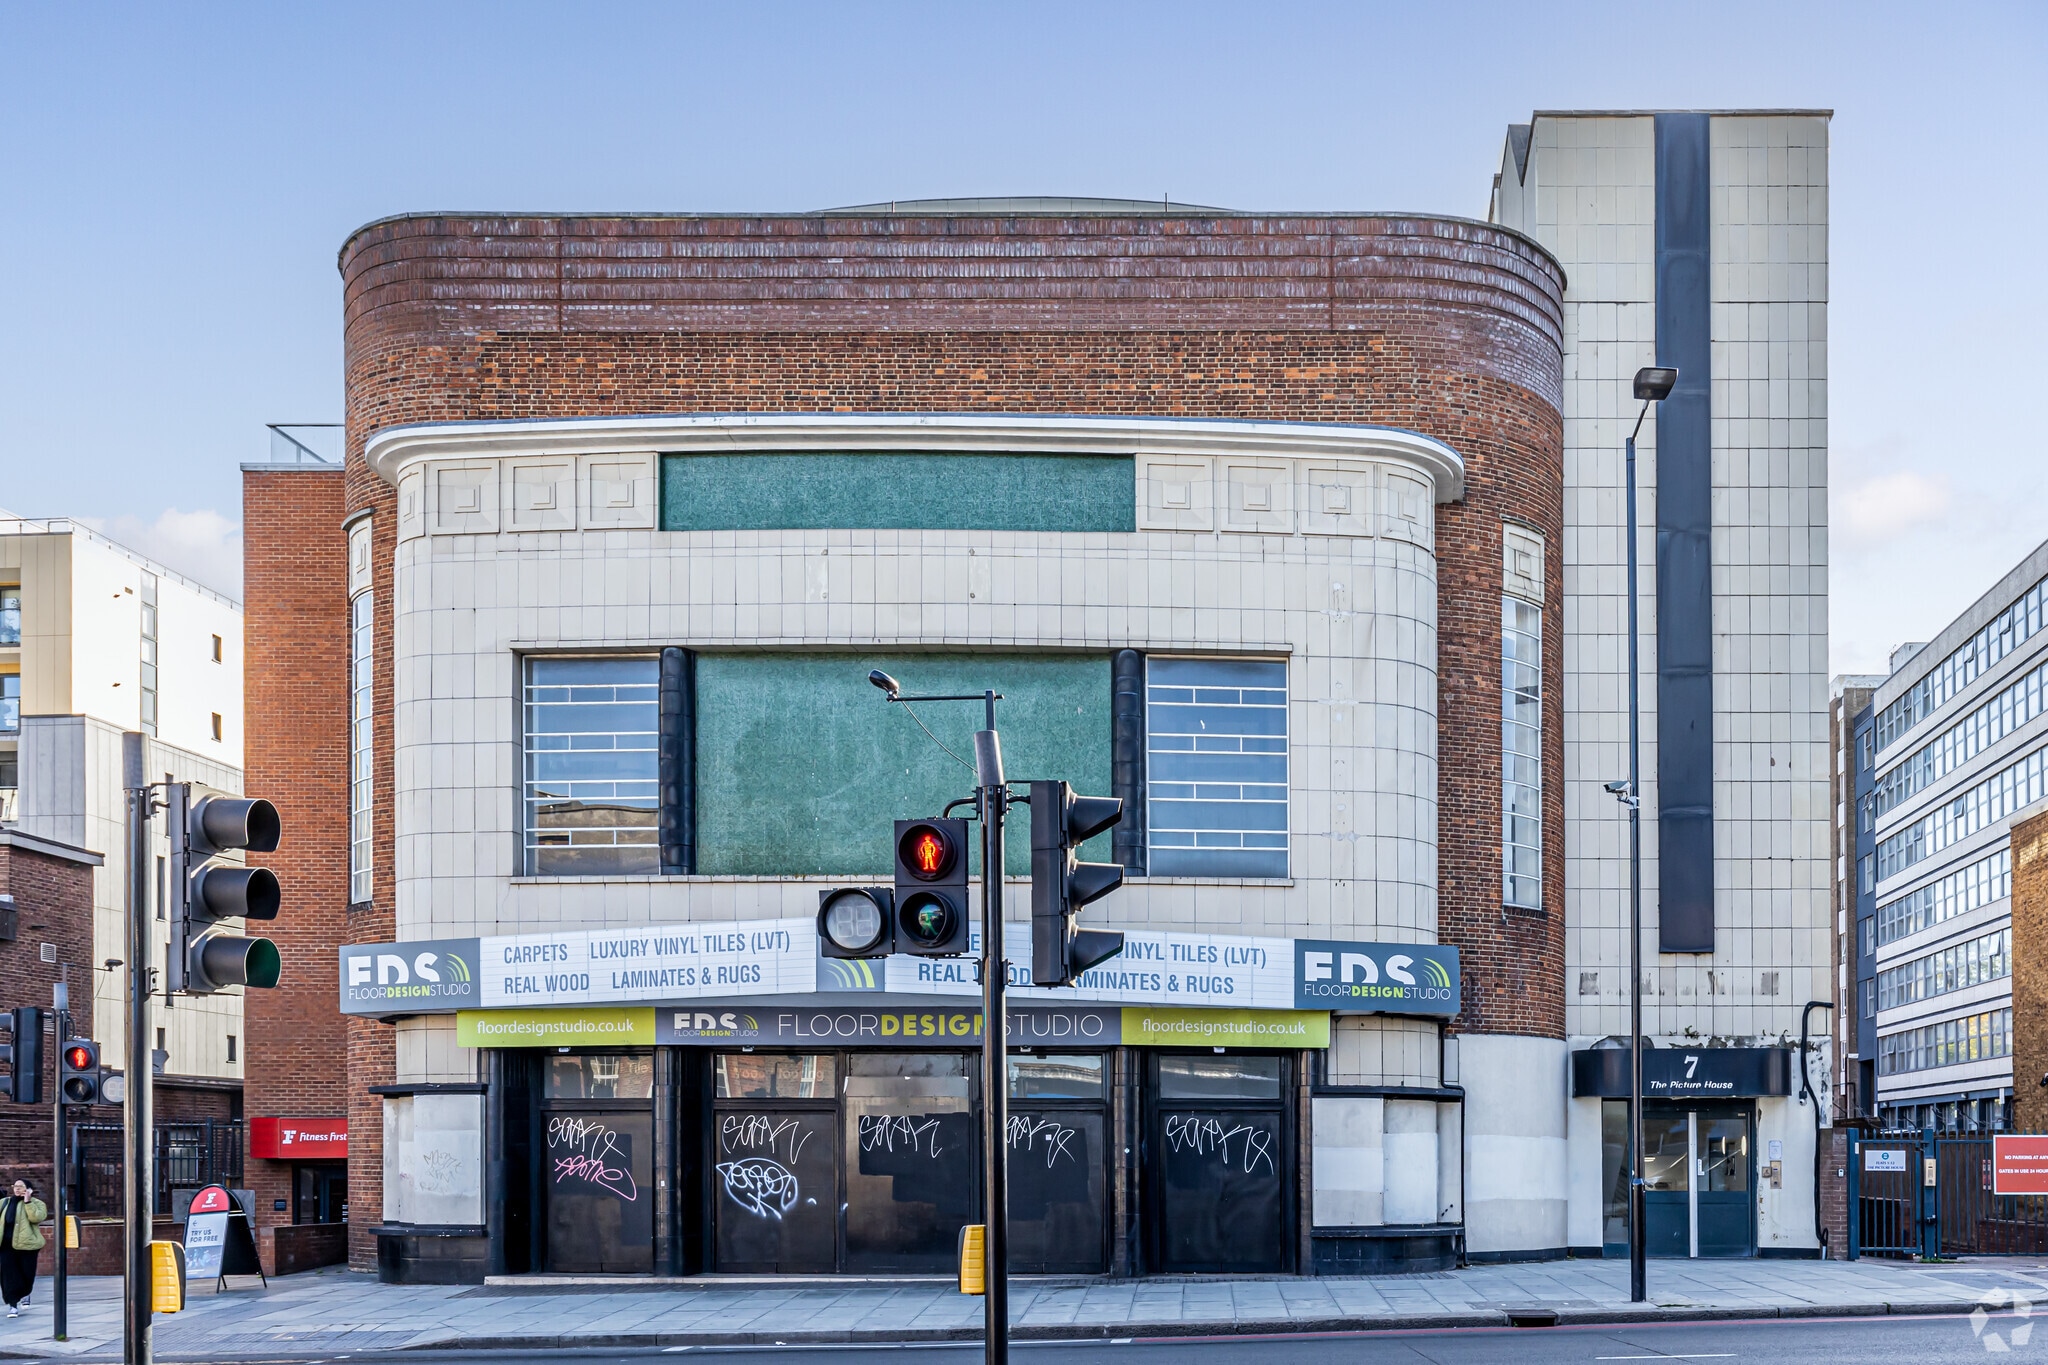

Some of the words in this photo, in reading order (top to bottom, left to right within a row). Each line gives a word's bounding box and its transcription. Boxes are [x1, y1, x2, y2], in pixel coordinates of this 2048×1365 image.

[504, 944, 568, 964] CARPETS
[591, 939, 648, 959] LUXURY
[654, 936, 698, 956] VINYL
[704, 934, 745, 953] TILES
[752, 931, 790, 955] (LVT)
[1116, 941, 1167, 961] INYL
[1171, 944, 1217, 964] TILES
[1225, 946, 1266, 970] (LVT)
[348, 952, 441, 986] FDS
[504, 976, 540, 994] REAL
[545, 973, 589, 992] WOOD
[612, 968, 695, 989] LAMINATES
[701, 967, 712, 985] &
[718, 965, 760, 984] RUGS
[918, 964, 967, 983] REAL
[973, 966, 1031, 985] OD
[1304, 951, 1416, 985] FDS
[1076, 971, 1161, 992] MINATES
[1168, 974, 1180, 992] &
[1186, 975, 1234, 994] RUGS
[477, 1018, 634, 1035] floordesignstudio.co.uk
[674, 1013, 738, 1029] FDS
[1142, 1018, 1306, 1036] floordesignstudio.co.uk
[1683, 1055, 1698, 1079] 7
[1650, 1081, 1667, 1089] The
[1670, 1081, 1702, 1089] Picture
[1704, 1081, 1733, 1089] House
[299, 1132, 328, 1142] fitness
[329, 1131, 348, 1142] first
